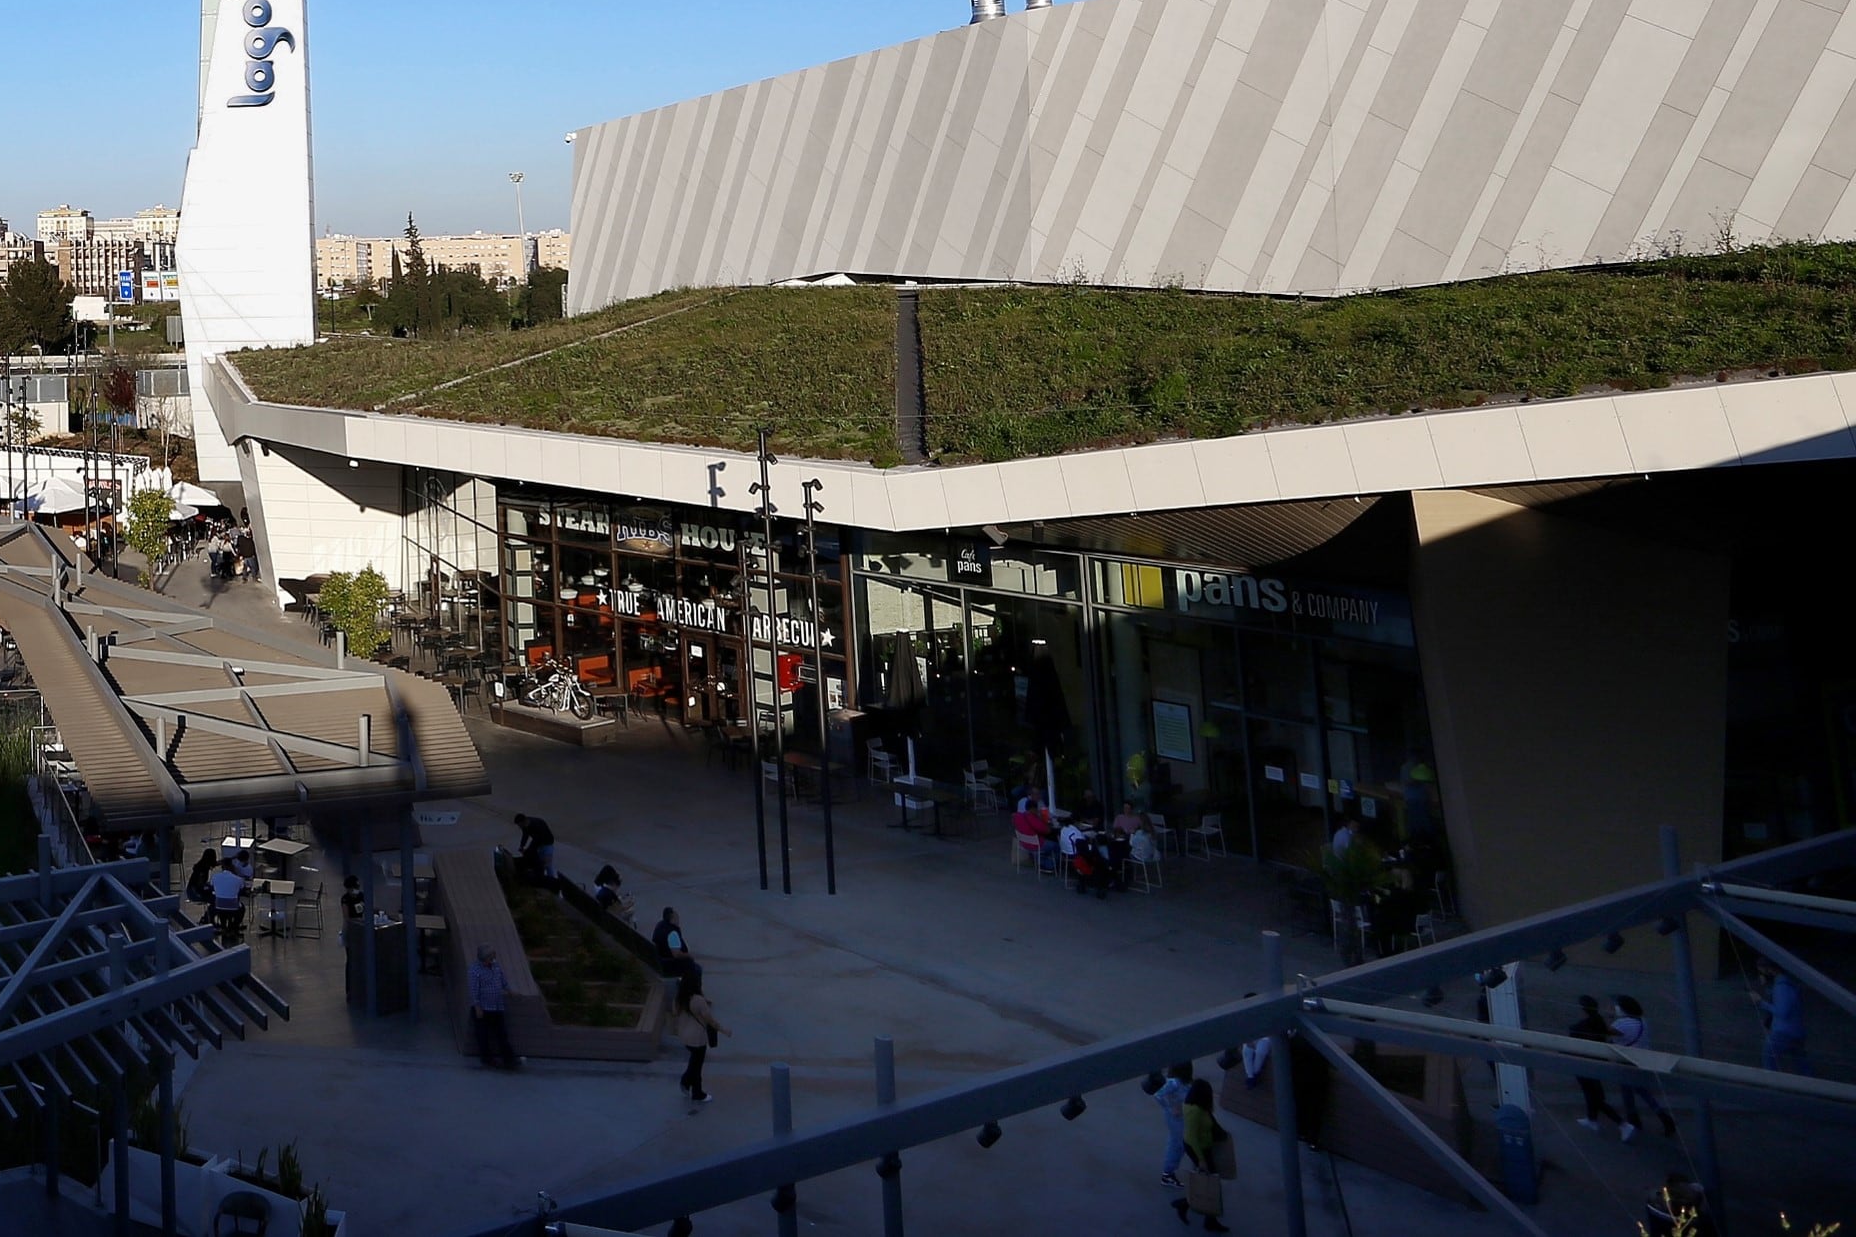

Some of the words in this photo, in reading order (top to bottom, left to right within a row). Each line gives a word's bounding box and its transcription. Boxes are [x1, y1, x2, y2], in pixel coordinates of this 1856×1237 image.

[957, 560, 982, 574] pans
[609, 588, 641, 616] TRUE
[656, 597, 726, 632] AMERICAN
[1175, 568, 1288, 612] pans
[1292, 591, 1303, 615] &
[1307, 593, 1379, 626] COMPANY
